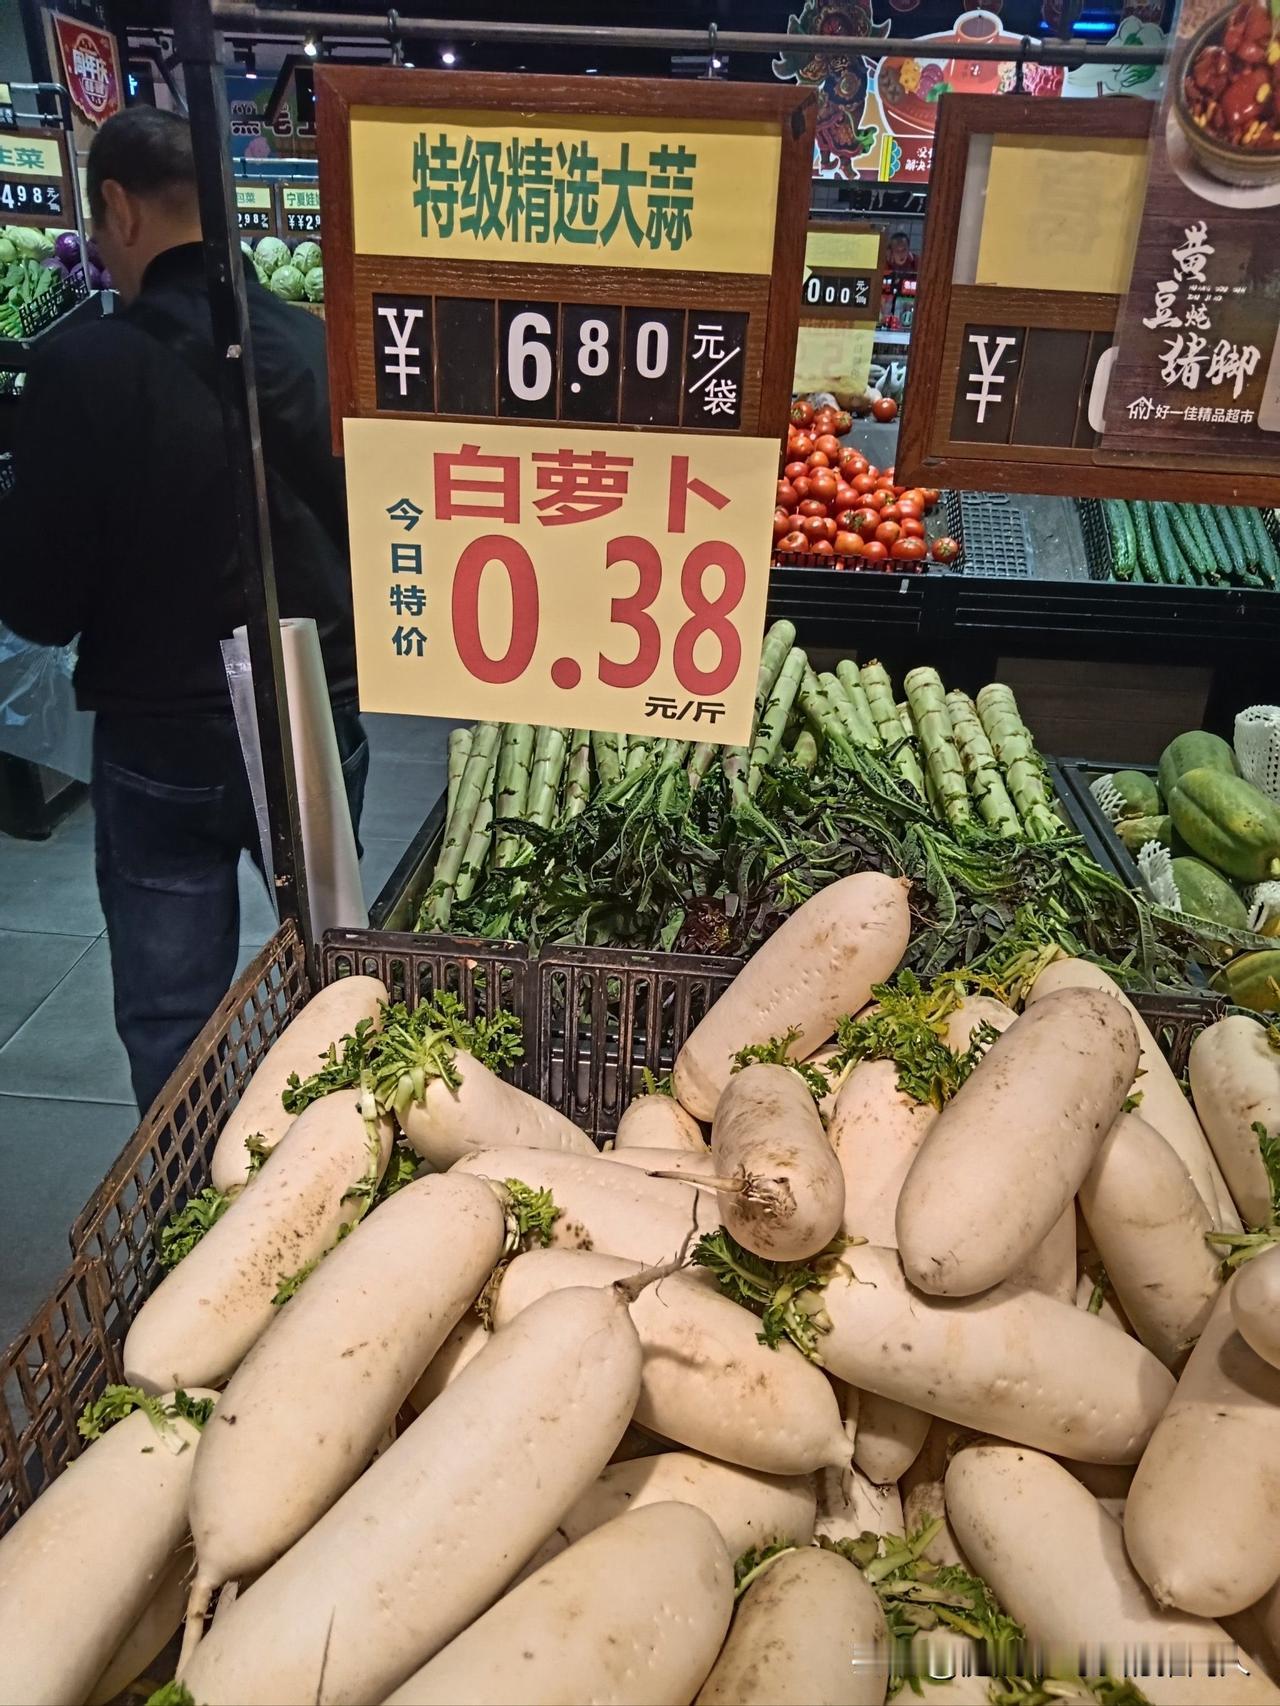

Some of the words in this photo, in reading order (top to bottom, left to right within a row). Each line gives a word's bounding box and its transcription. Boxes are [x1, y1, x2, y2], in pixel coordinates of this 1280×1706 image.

[2, 184, 42, 208] 4.98
[412, 132, 697, 251] 特级精选大蒜
[378, 308, 424, 395] ¥
[508, 312, 669, 401] 6.80
[689, 324, 741, 416] 元/袋
[965, 335, 1016, 424] ¥
[1155, 405, 1255, 424] 好一佳精品超市
[433, 443, 731, 534] 白萝卜
[386, 497, 428, 658] 今日特价
[451, 534, 747, 697] 0.38
[645, 695, 726, 724] 元/斤
